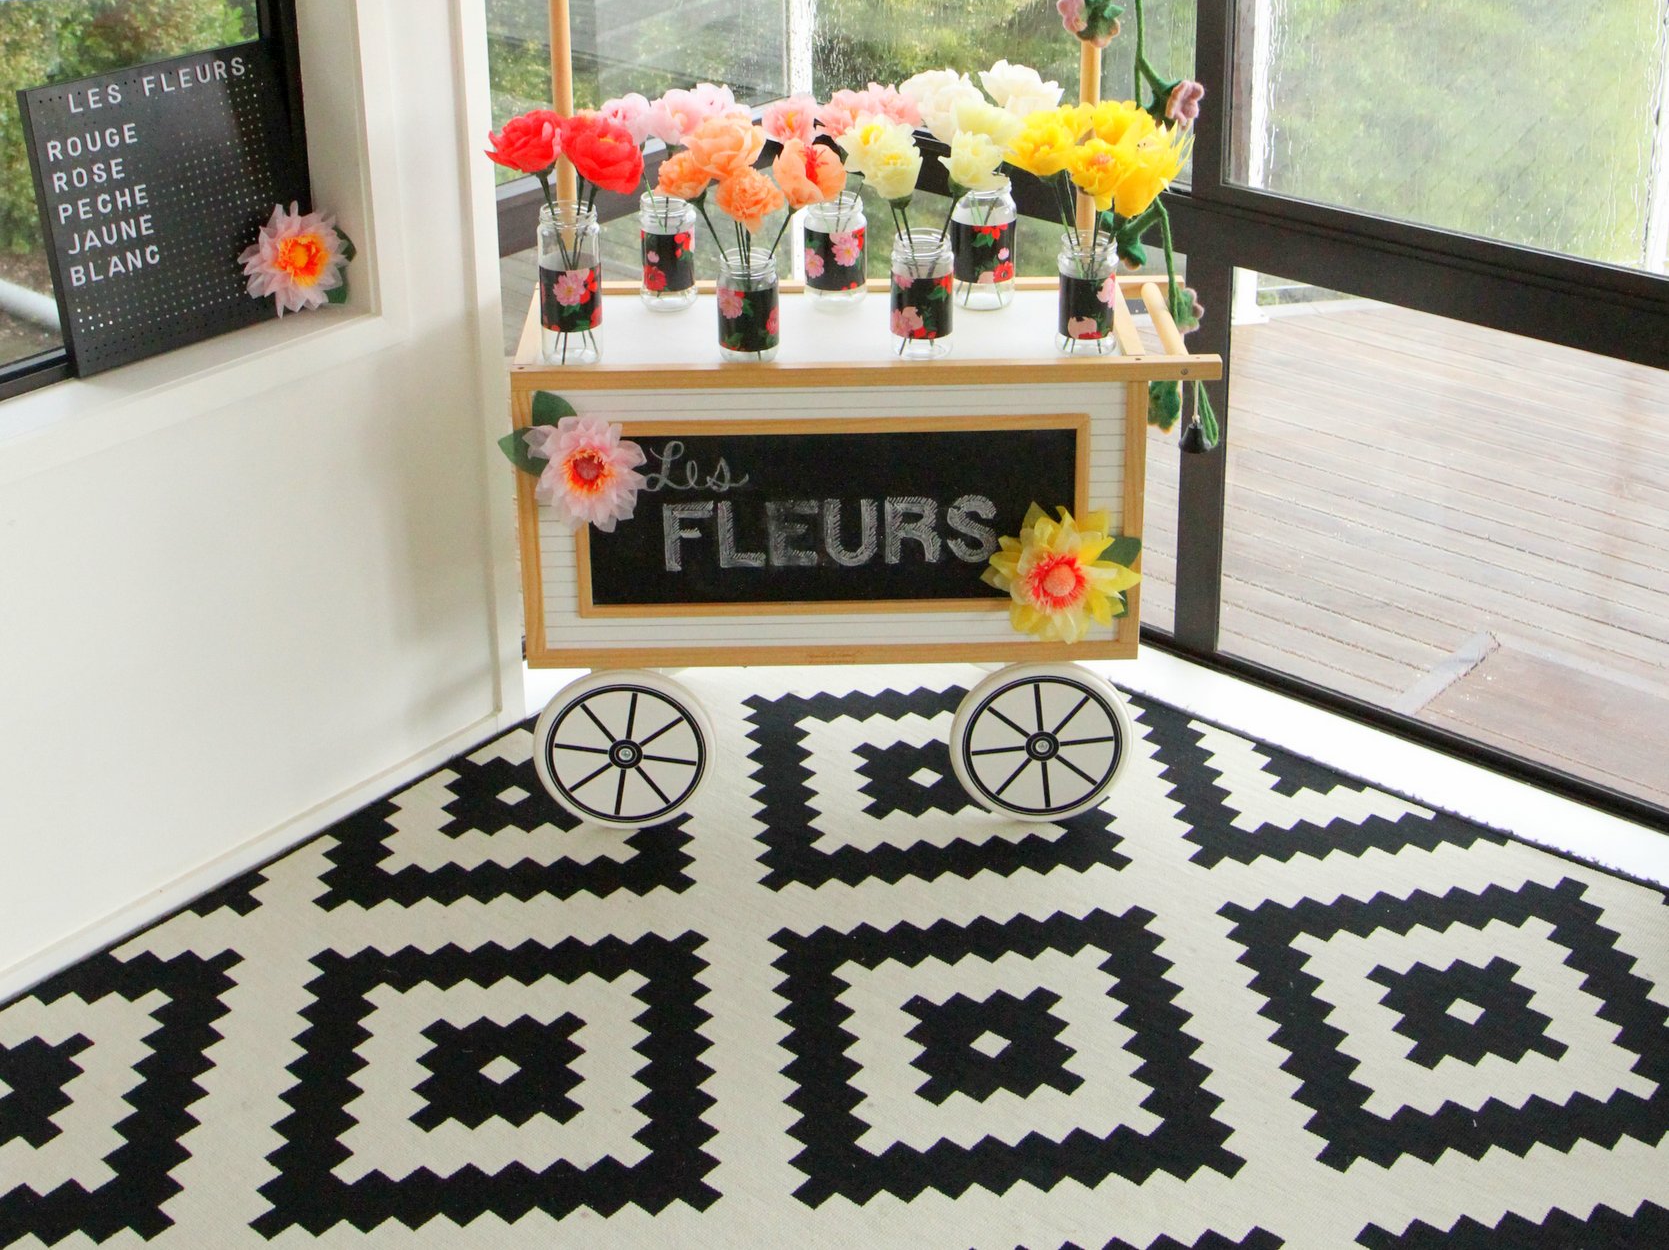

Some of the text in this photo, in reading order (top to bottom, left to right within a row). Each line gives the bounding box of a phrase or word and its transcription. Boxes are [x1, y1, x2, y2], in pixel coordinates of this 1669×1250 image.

[68, 56, 246, 114] LES FLEURS
[47, 123, 138, 162] ROUGE
[52, 158, 126, 194] ROSE
[58, 184, 149, 225] PECHE
[68, 215, 155, 255] JAUNE
[70, 245, 161, 287] BLANC
[641, 440, 750, 492] Les
[662, 493, 998, 572] FLEURS
